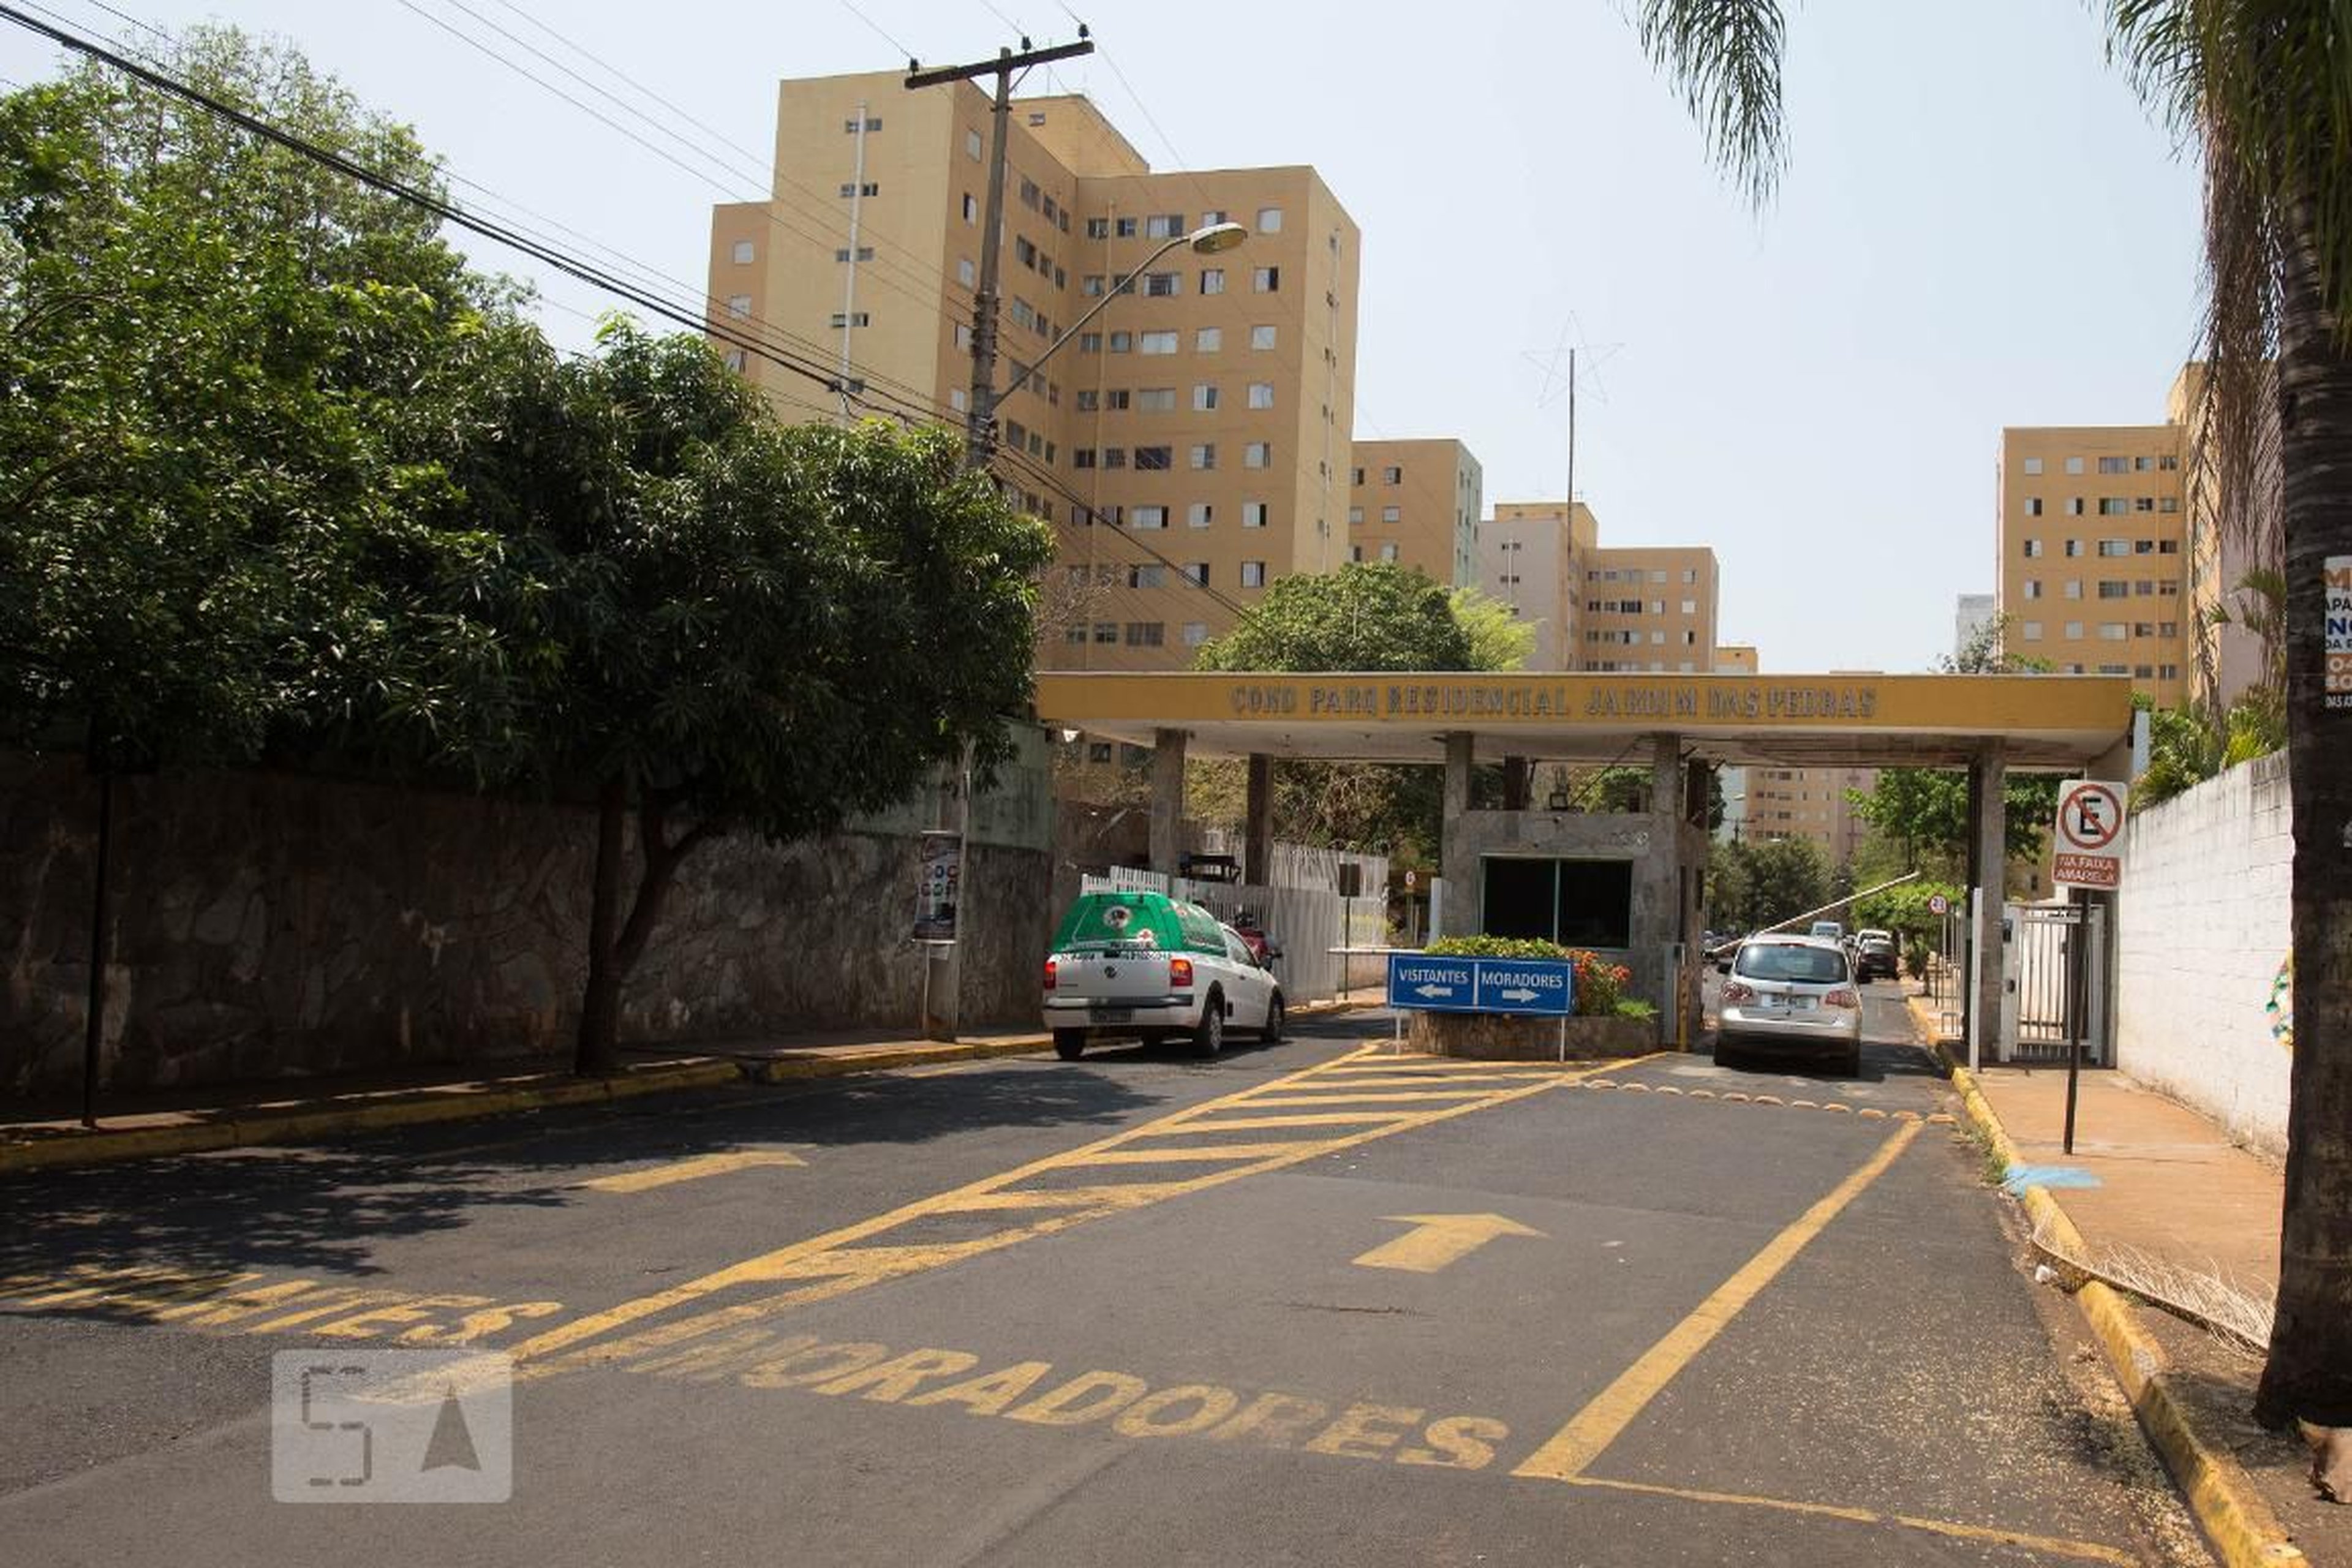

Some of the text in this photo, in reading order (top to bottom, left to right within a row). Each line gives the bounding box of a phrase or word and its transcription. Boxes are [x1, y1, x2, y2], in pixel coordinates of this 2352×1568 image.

[1310, 685, 1378, 717] PARQ
[1387, 685, 1569, 716] RESIDENCIAL
[1585, 686, 1697, 717] JARDIM
[1706, 686, 1760, 718] DAS
[1768, 687, 1876, 718] PEDRAS
[2059, 856, 2114, 872] NA FAIXA
[2056, 869, 2117, 884] AMARELA
[1400, 968, 1469, 984] VISITANTES
[1481, 970, 1563, 988] MORADORES
